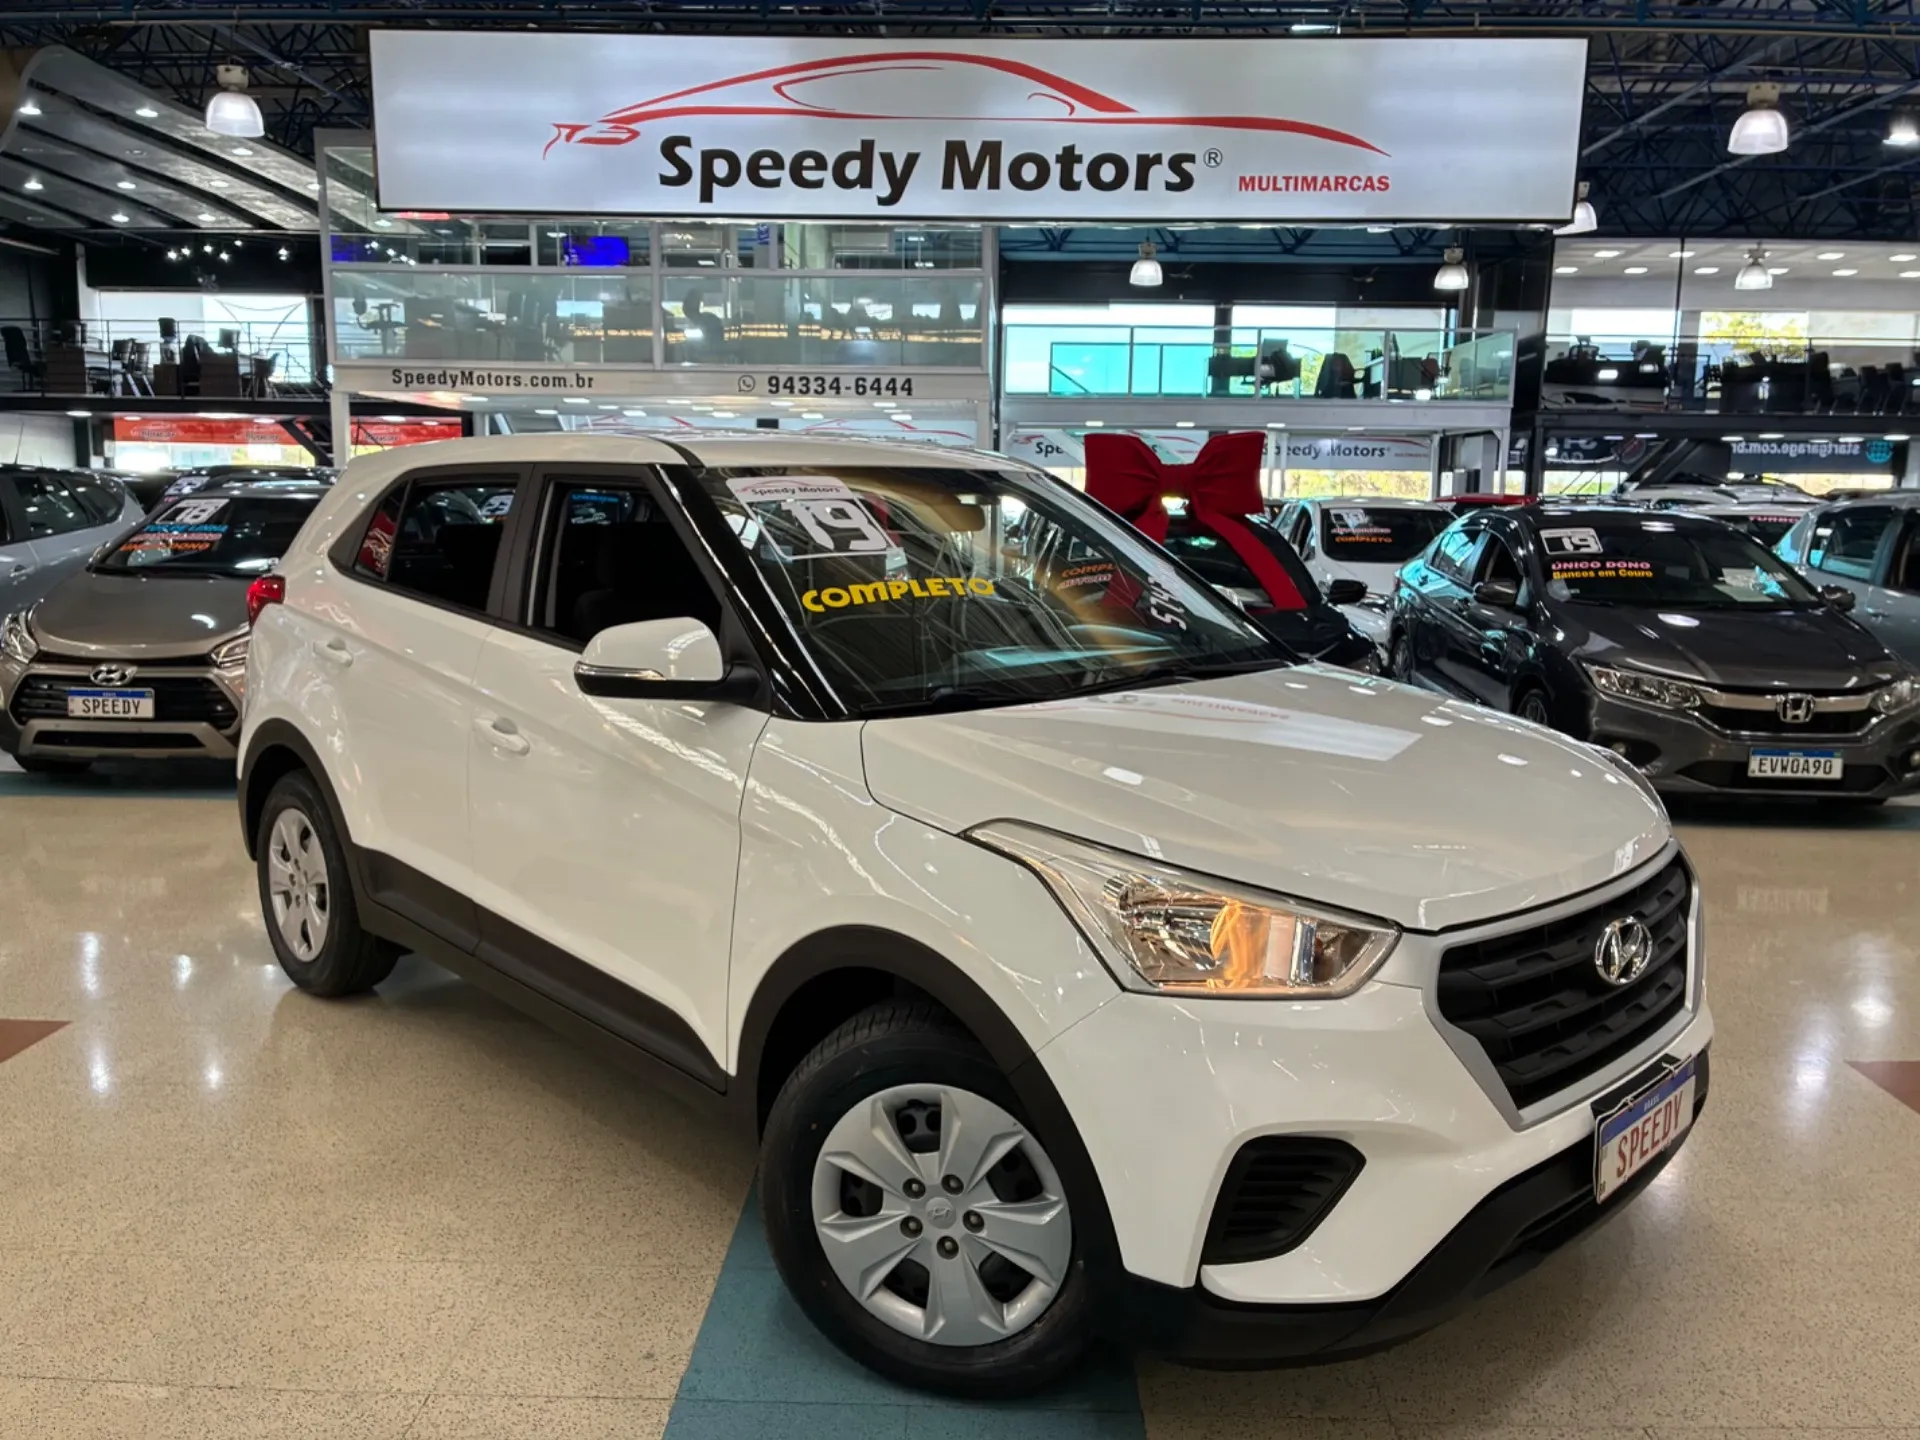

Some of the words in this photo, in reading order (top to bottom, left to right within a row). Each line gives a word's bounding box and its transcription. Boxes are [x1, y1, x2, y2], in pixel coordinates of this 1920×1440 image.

[658, 135, 920, 206] Speedy
[1238, 174, 1391, 193] MULTIMARCAS
[391, 369, 594, 390] SpeedyMotors.com.br
[767, 375, 914, 397] 94334-6444
[751, 487, 796, 496] Speedy
[782, 501, 887, 550] 19
[1561, 536, 1600, 552] 19
[1552, 561, 1601, 570] ÚNICO
[1606, 561, 1650, 569] DONO
[1553, 570, 1595, 579] Bancos
[1619, 569, 1653, 577] Couro
[801, 577, 996, 612] COMPLETO
[82, 698, 141, 714] SPEEDY
[1616, 1090, 1683, 1178] SPEEDY
